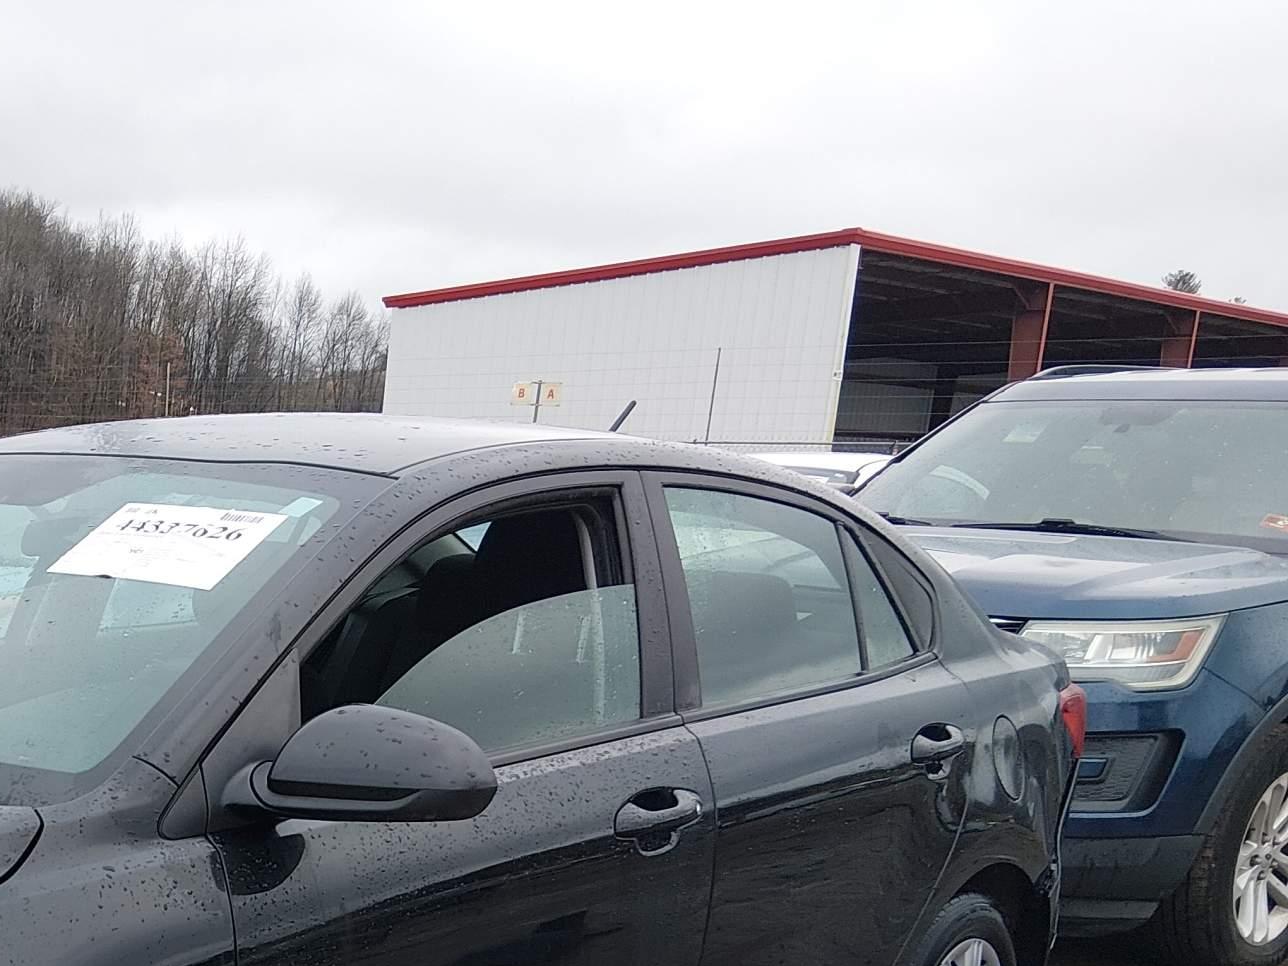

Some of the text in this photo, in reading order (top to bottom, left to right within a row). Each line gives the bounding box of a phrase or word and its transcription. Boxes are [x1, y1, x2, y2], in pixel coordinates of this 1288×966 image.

[517, 388, 526, 398] B
[547, 388, 555, 399] A
[115, 519, 244, 542] 44337626
